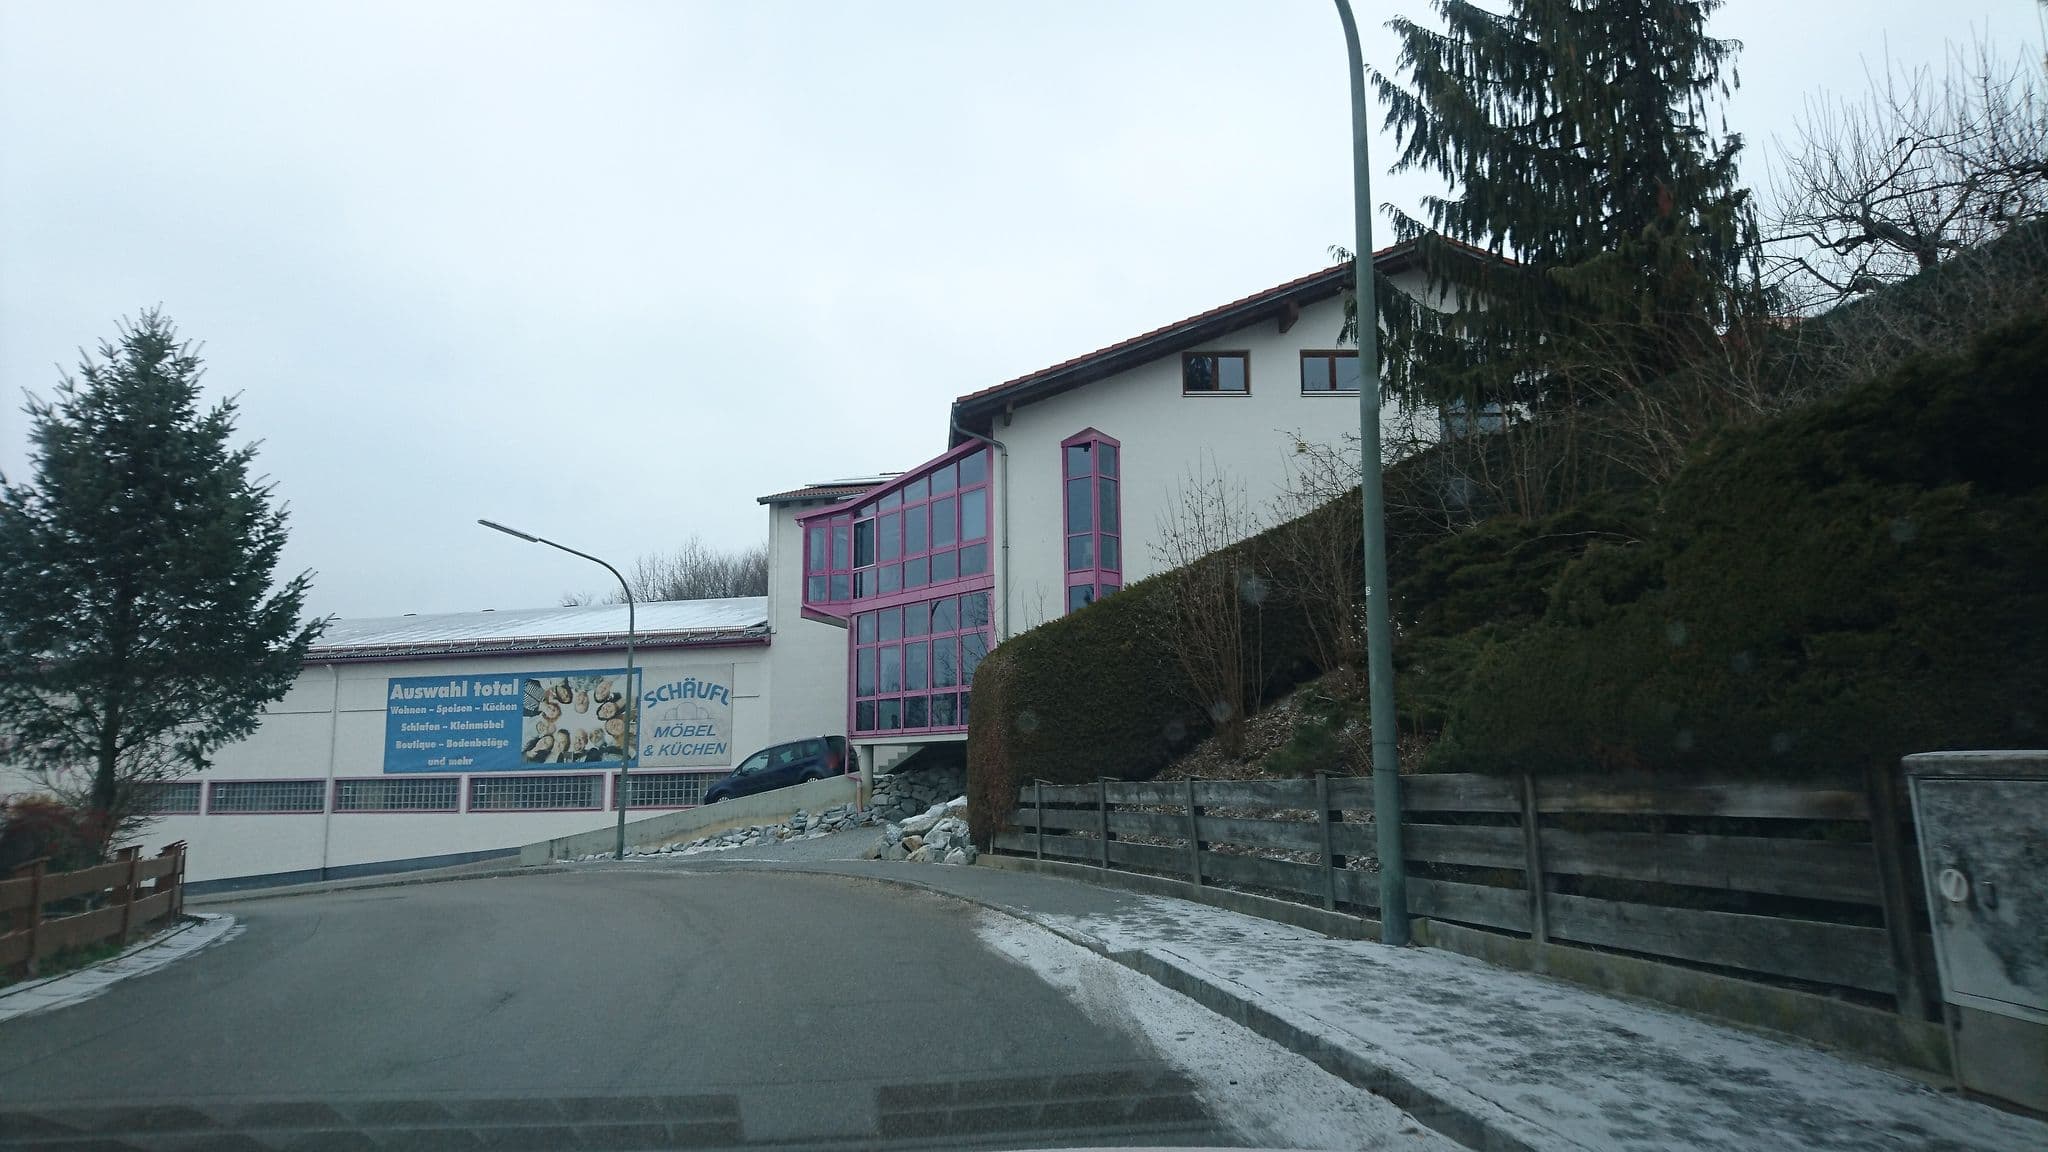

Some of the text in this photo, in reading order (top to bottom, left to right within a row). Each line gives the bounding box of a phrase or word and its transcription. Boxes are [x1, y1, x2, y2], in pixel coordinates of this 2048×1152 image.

[390, 679, 519, 699] Auswahl total
[644, 678, 729, 708] SCHÄUFL
[390, 706, 427, 714] Wohnen
[436, 704, 472, 715] Speisen
[482, 702, 518, 712] Küchen
[400, 722, 440, 732] Schlafen
[450, 720, 504, 730] Kleinmöbel
[654, 723, 716, 738] MÖBEL
[396, 740, 436, 750] Boutique
[446, 738, 509, 748] Bodenbeläge
[644, 742, 727, 756] & KÜCHEN
[428, 756, 474, 766] und mehr
